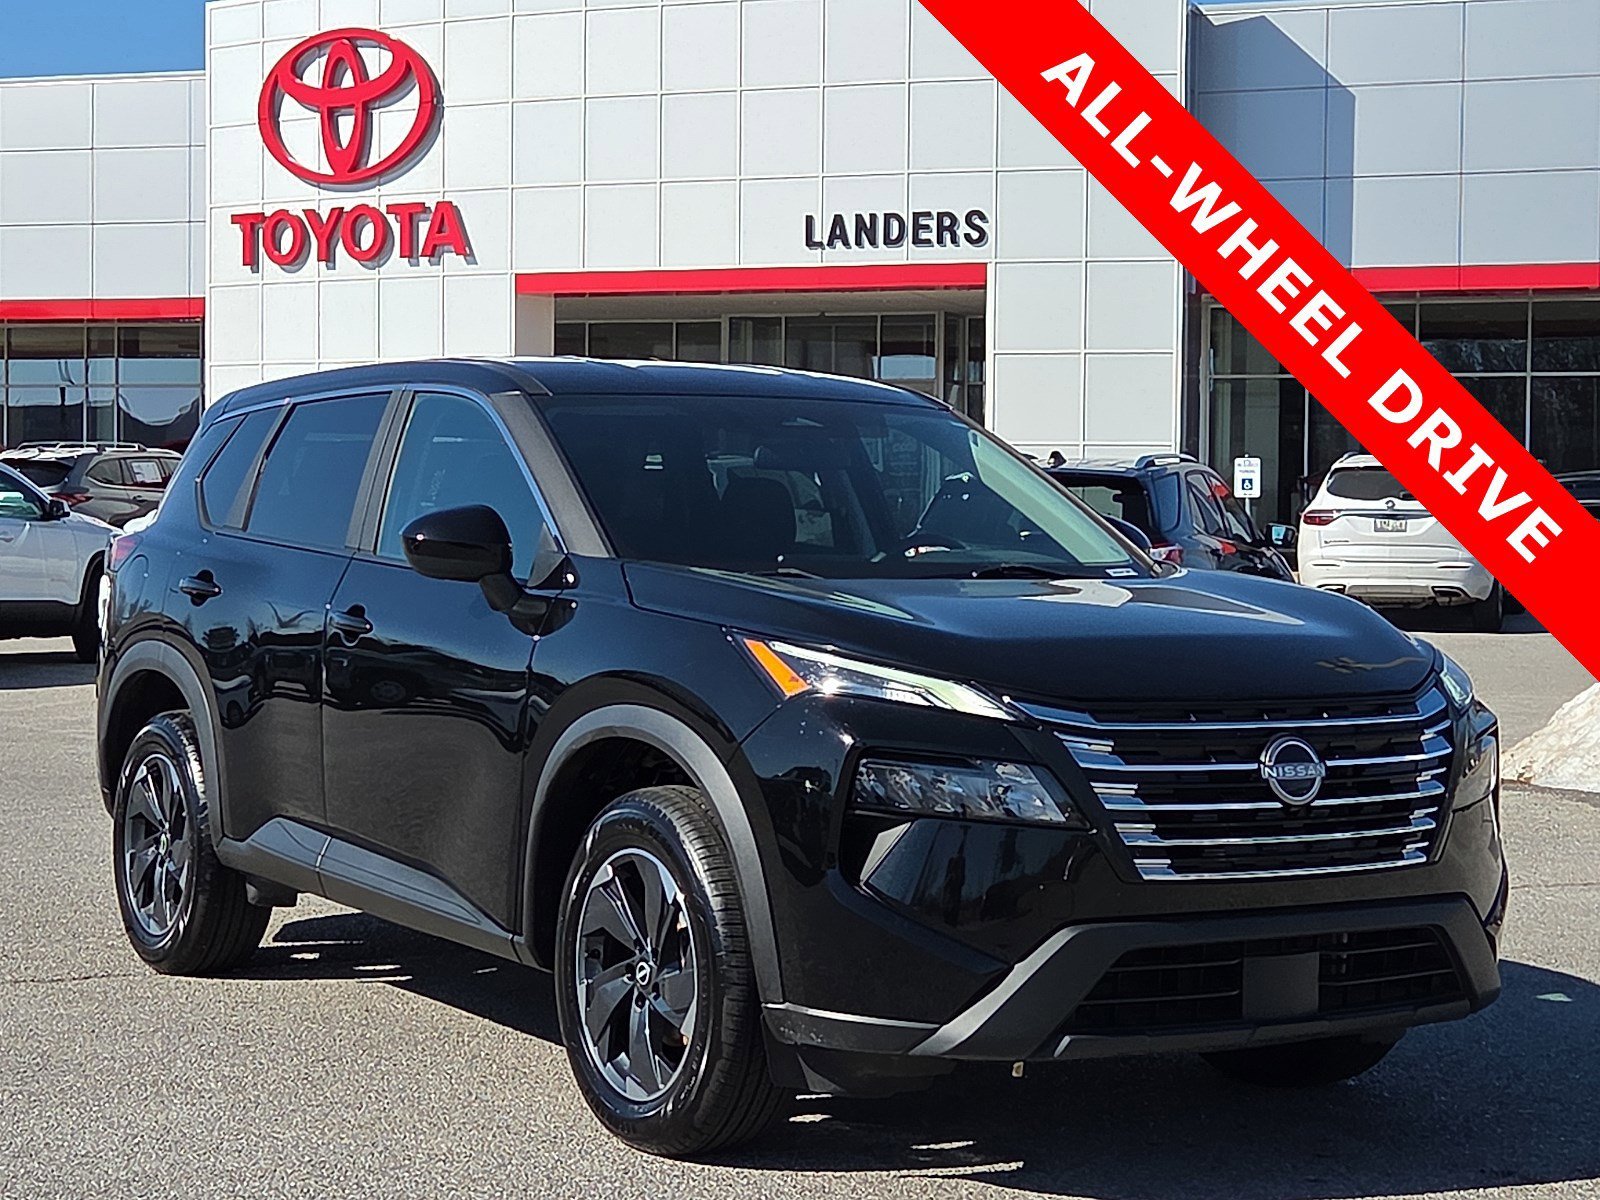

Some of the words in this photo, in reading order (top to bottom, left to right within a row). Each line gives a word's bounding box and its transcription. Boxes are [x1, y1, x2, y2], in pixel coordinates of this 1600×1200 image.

[231, 201, 470, 268] TOYOTA
[805, 209, 989, 249] LANDERS
[1260, 764, 1325, 779] NISSAN
